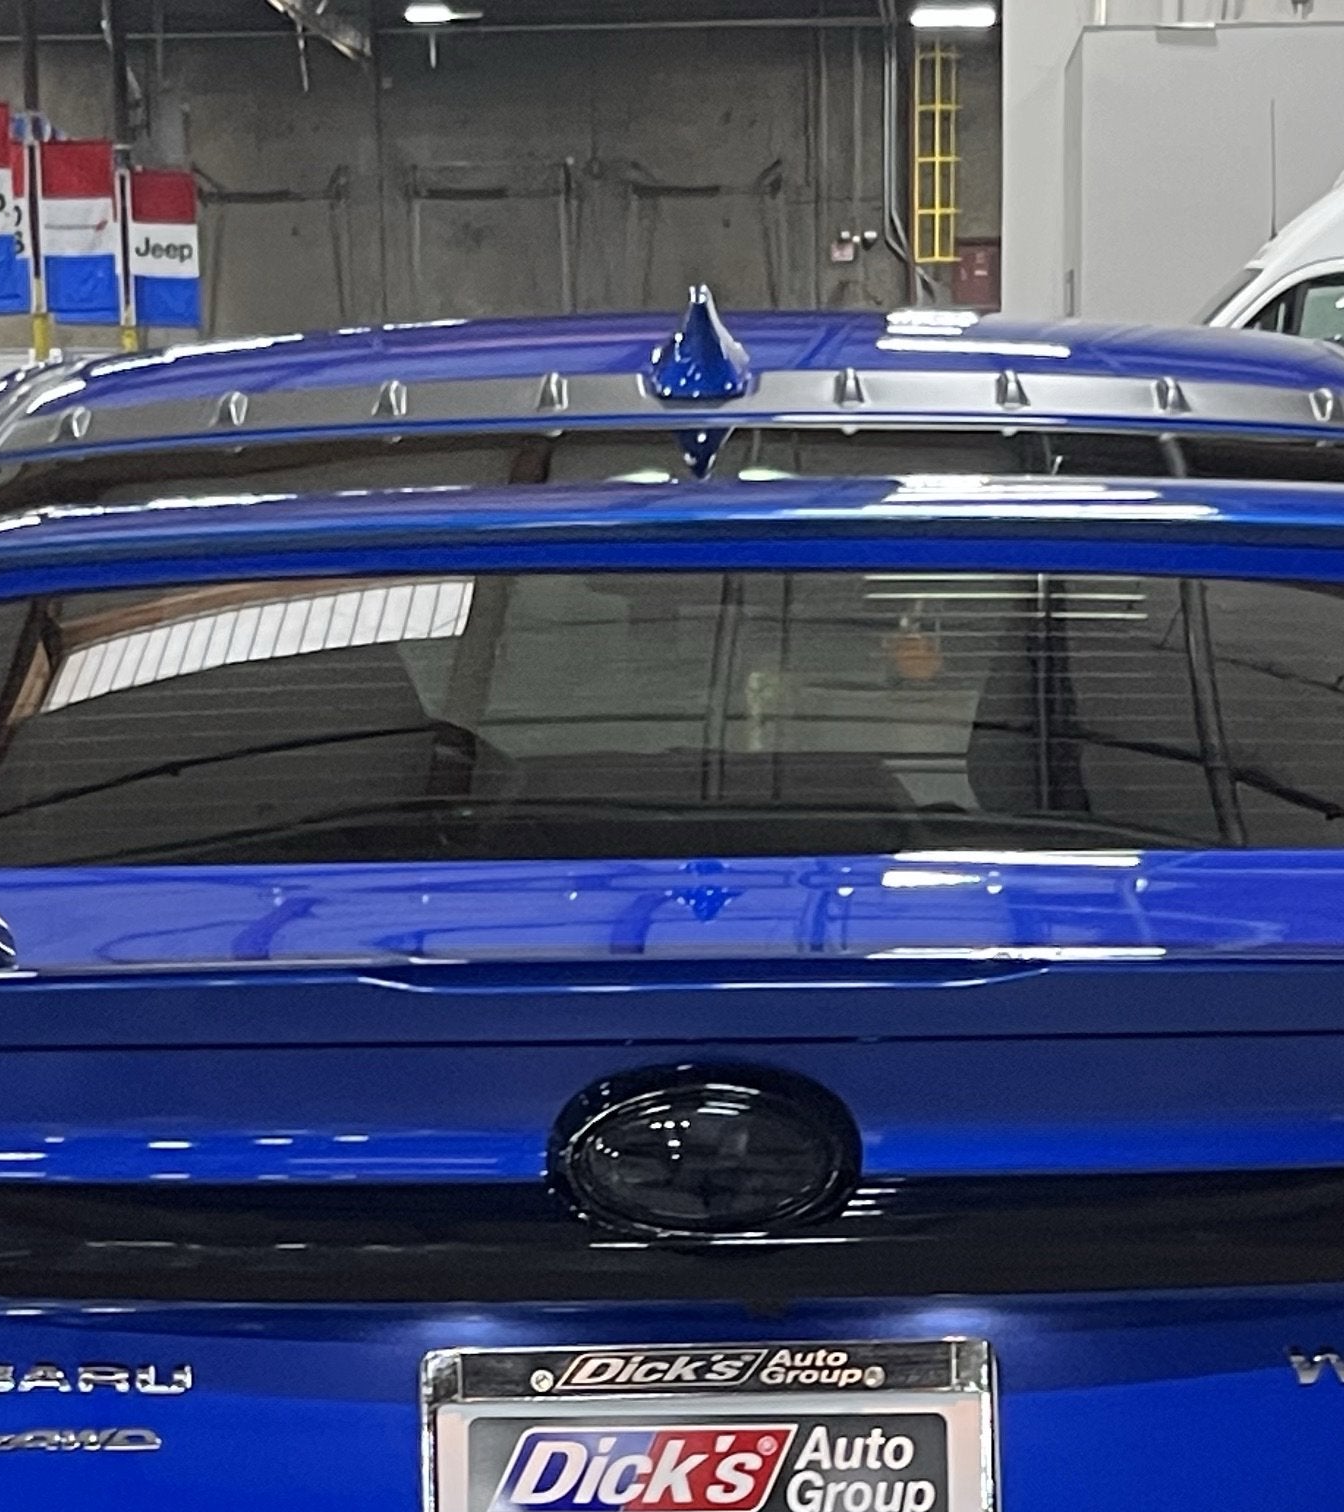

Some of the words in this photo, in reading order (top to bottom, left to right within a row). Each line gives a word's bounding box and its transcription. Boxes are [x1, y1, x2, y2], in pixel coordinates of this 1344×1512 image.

[134, 237, 193, 262] Jeep
[771, 1348, 848, 1368] Auto
[765, 1366, 862, 1387] Group
[794, 1426, 915, 1470] Auto
